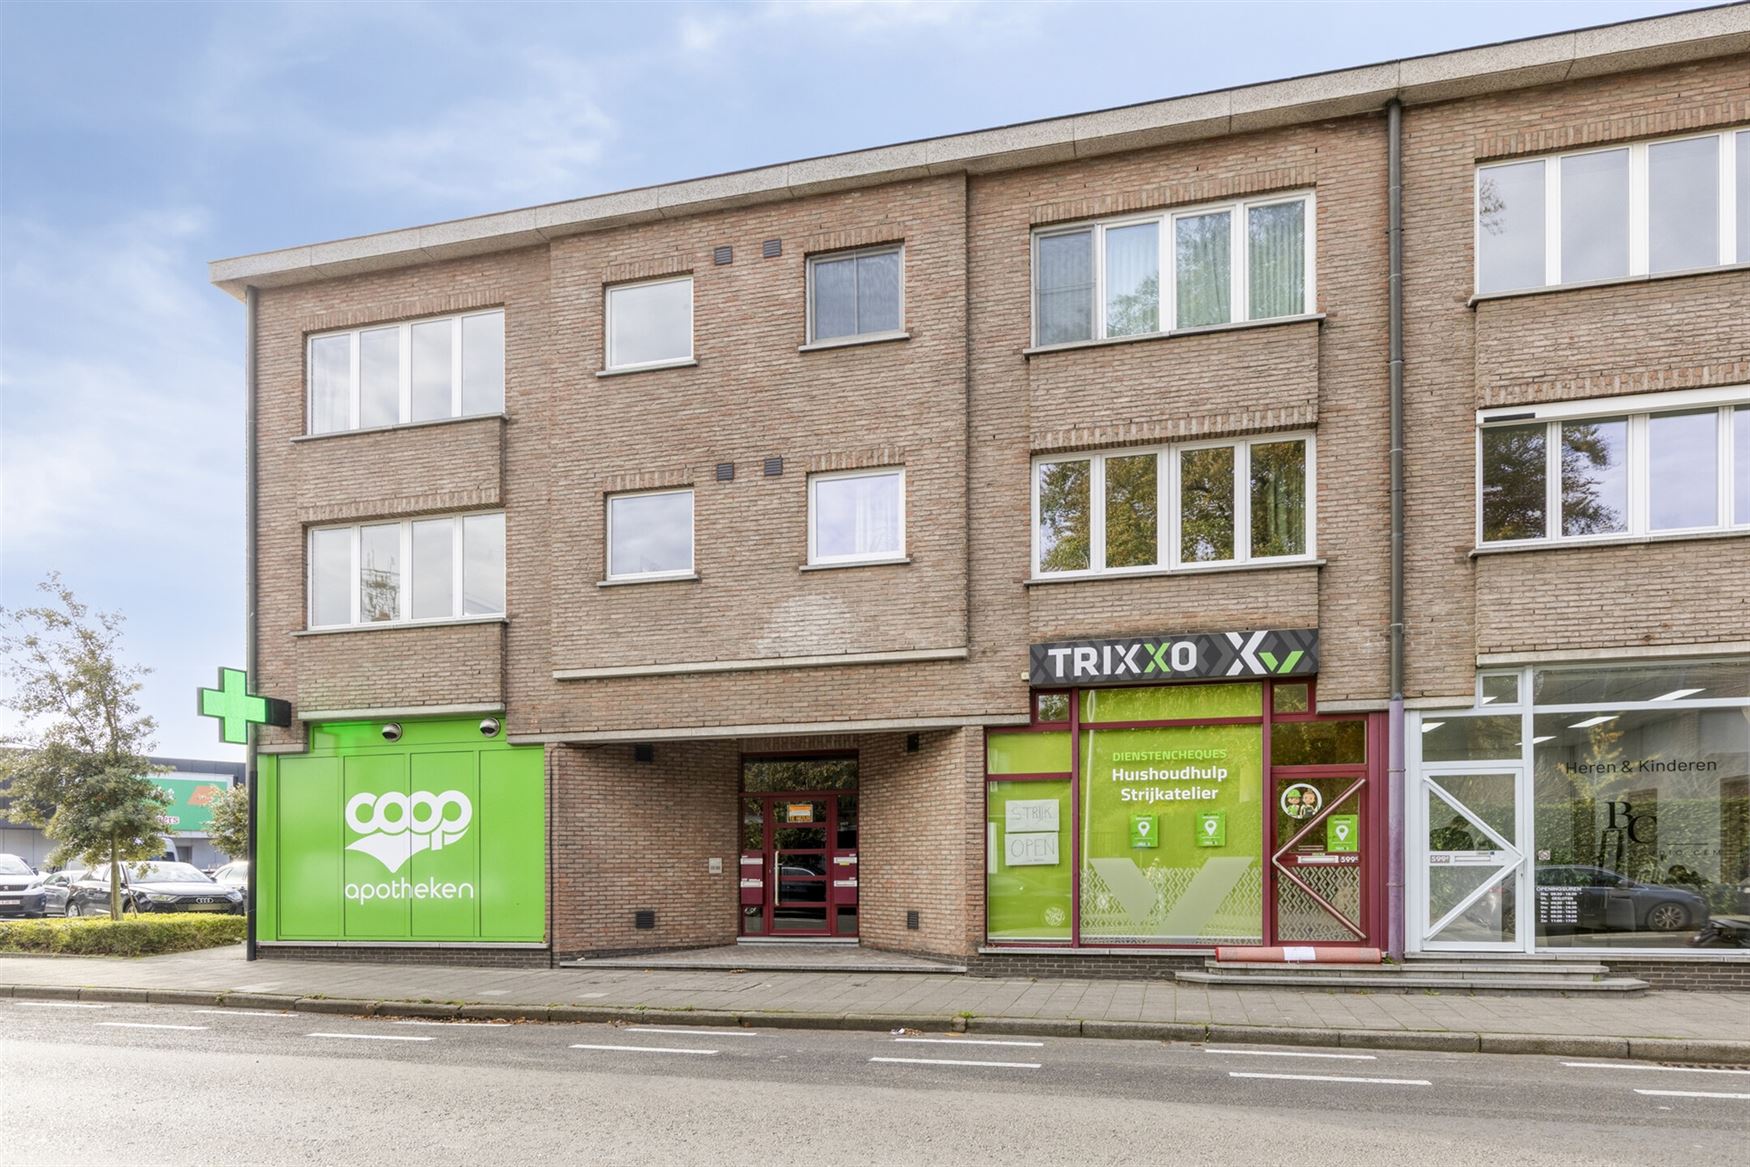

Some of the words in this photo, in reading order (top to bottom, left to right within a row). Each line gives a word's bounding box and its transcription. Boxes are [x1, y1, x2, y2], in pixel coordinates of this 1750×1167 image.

[1048, 641, 1198, 678] TRIXXO
[1112, 749, 1228, 762] DIENSTENCHEQUES
[1112, 765, 1228, 782] Huishoudhulp
[1566, 762, 1616, 774] Heren
[1621, 760, 1633, 773] &
[1639, 759, 1718, 772] Kinderen
[1121, 787, 1219, 804] Strijkatelier
[1011, 806, 1053, 822] STRIJK
[1010, 838, 1056, 857] OPEN
[345, 876, 474, 905] apotheken
